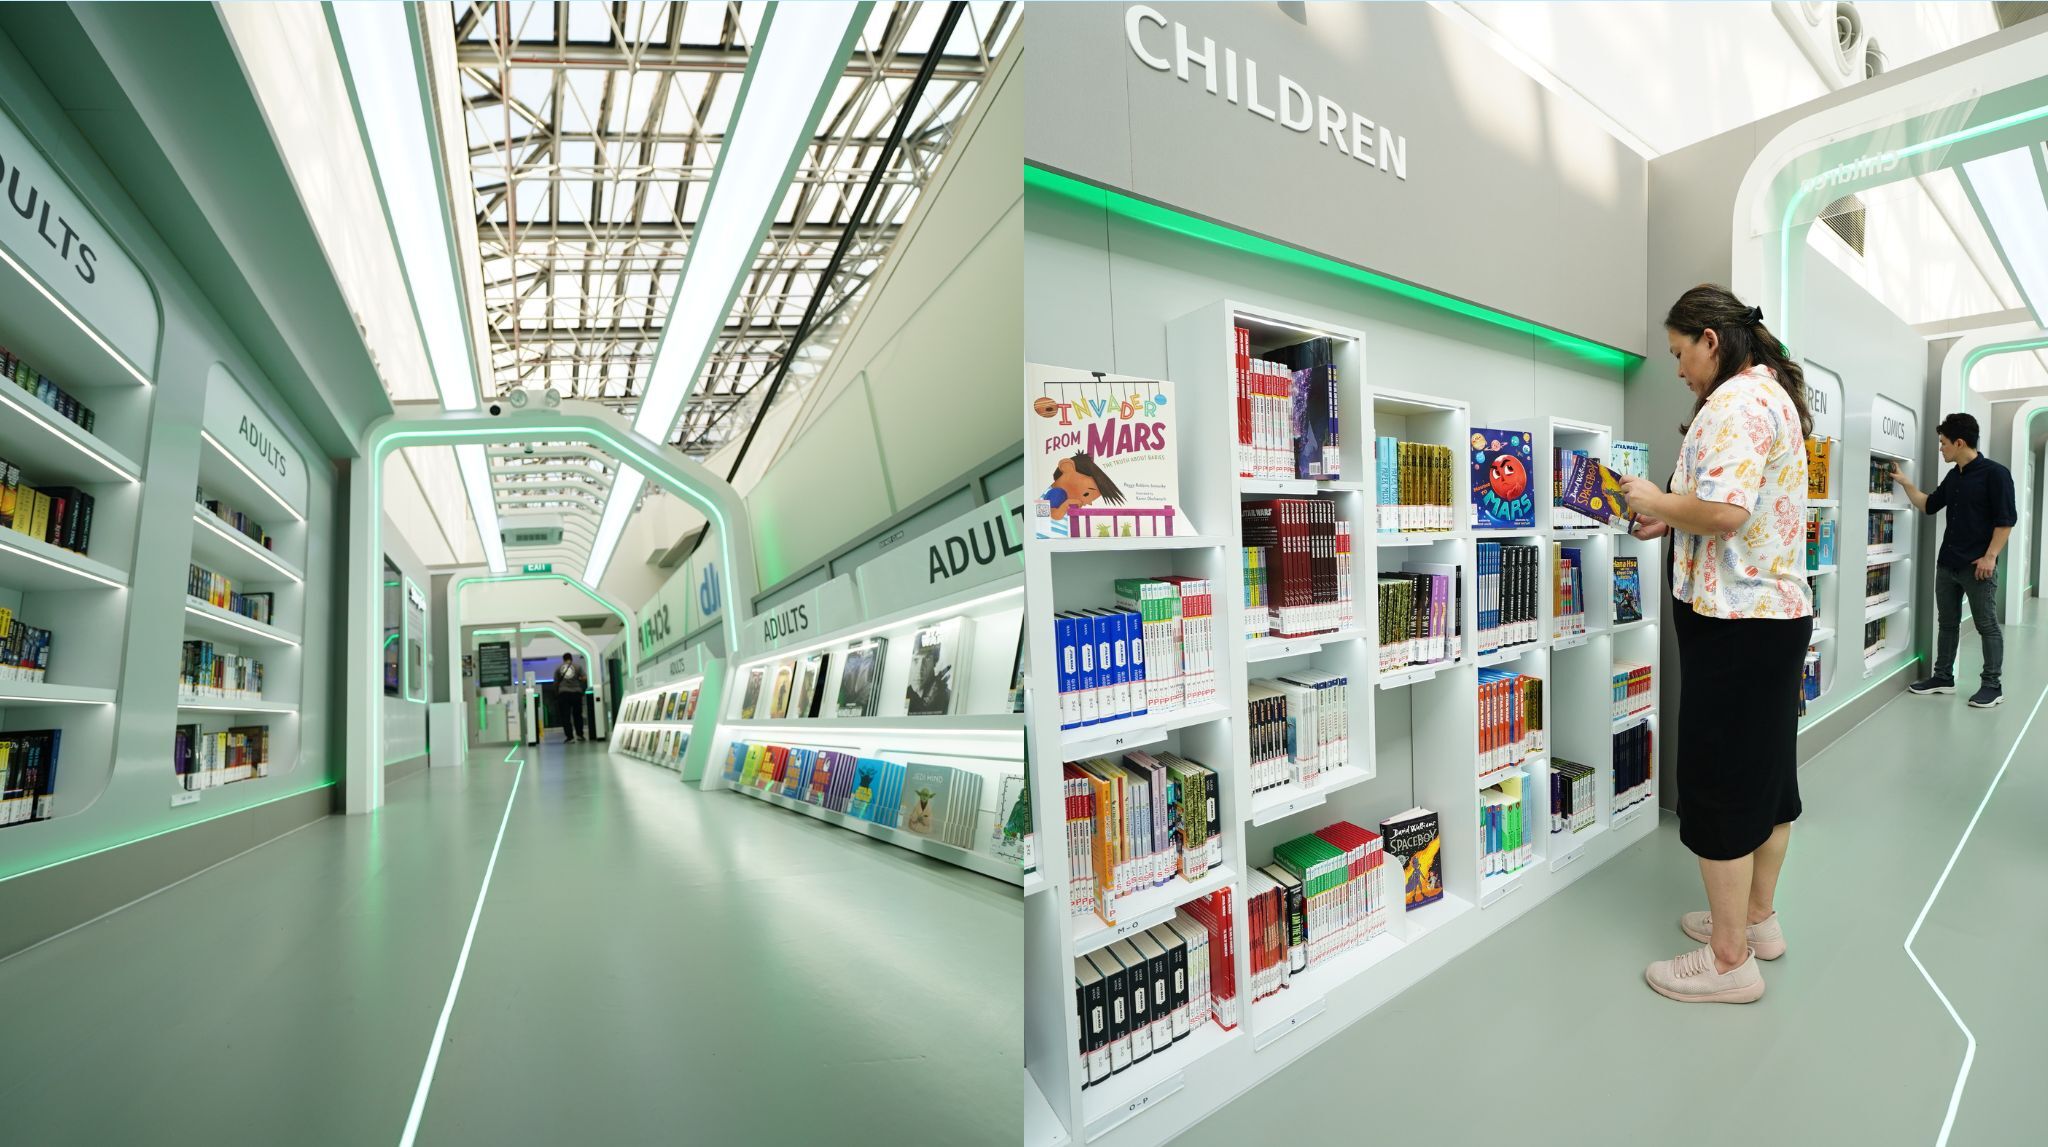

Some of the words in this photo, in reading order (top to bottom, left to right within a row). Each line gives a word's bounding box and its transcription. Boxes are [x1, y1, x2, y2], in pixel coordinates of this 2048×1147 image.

[1124, 3, 1408, 181] CHILDREN
[1057, 393, 1157, 426] INVADER
[1805, 386, 1828, 415] REN
[1045, 430, 1081, 454] FROM
[1087, 418, 1166, 462] MARS
[1882, 415, 1905, 441] COMICS
[239, 415, 286, 477] ADULTS
[1381, 468, 1389, 485] PAPER
[1577, 458, 1599, 506] SPACEBOY
[1483, 490, 1532, 520] MARS
[764, 604, 808, 642] ADULTS
[1389, 826, 1410, 840] David
[1390, 828, 1437, 855] SPACEBOY
[1292, 924, 1301, 936] THE
